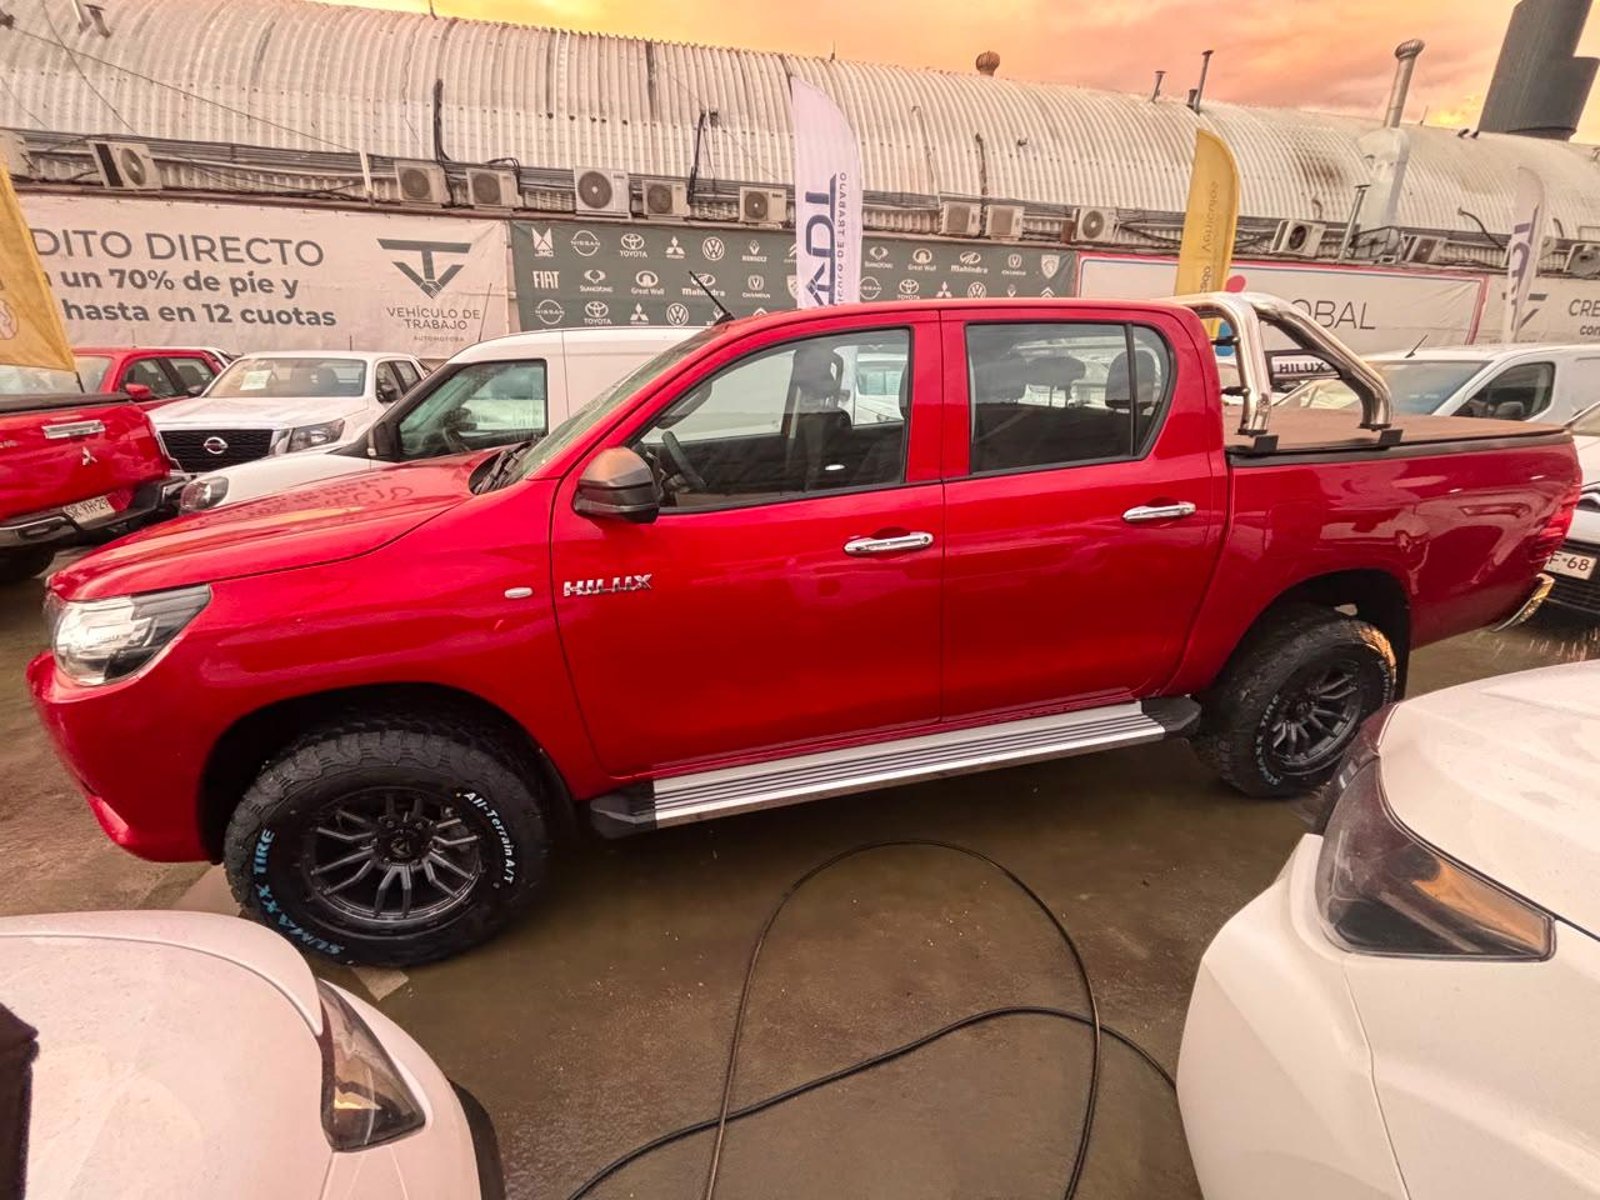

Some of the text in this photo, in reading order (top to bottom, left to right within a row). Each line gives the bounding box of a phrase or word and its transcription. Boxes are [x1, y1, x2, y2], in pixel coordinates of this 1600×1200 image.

[30, 228, 324, 267] DITO DIRECTO
[620, 250, 648, 258] TOYOTA
[61, 271, 102, 288] un
[109, 269, 175, 291] 70%
[183, 270, 221, 291] de
[230, 270, 273, 297] pie
[282, 278, 299, 299] y
[533, 270, 560, 289] FIAT
[61, 299, 337, 326] hasta en 12 cuotas
[386, 305, 481, 320] VEHÍCULO DE
[404, 318, 468, 330] TRABAJO
[1279, 362, 1325, 374] HILUX
[563, 573, 652, 597] HILUX
[463, 792, 516, 885] All-Terrain A/T
[253, 829, 276, 875] TIRE
